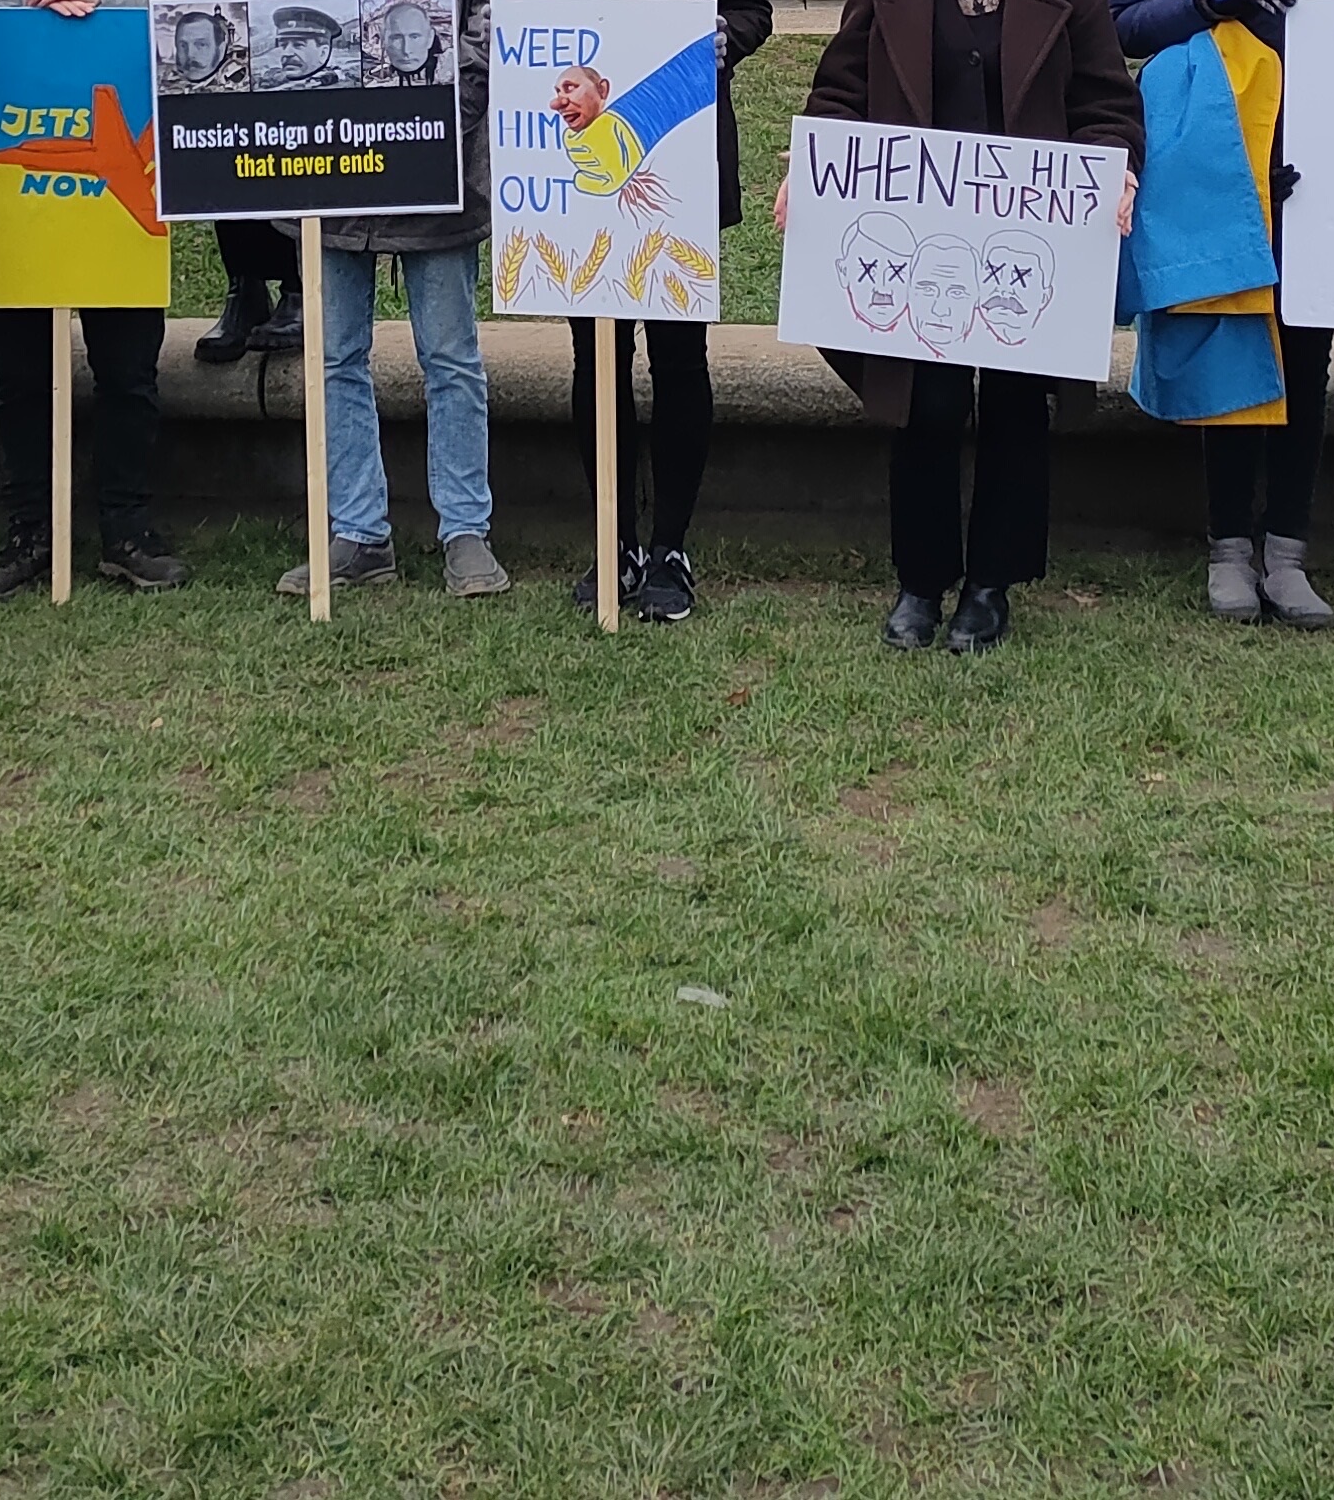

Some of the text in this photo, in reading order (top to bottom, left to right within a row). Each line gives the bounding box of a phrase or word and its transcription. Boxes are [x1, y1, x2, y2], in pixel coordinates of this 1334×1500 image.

[496, 26, 601, 68] WEED
[0, 104, 92, 137] JETS
[172, 115, 445, 151] Russia's Reign of Oppression
[497, 109, 564, 150] HIM
[235, 149, 385, 178] that never ends
[808, 132, 1107, 207] WHEN IS HIS
[21, 173, 109, 199] NOW
[499, 175, 574, 215] OUT
[963, 180, 1099, 227] TURN?
